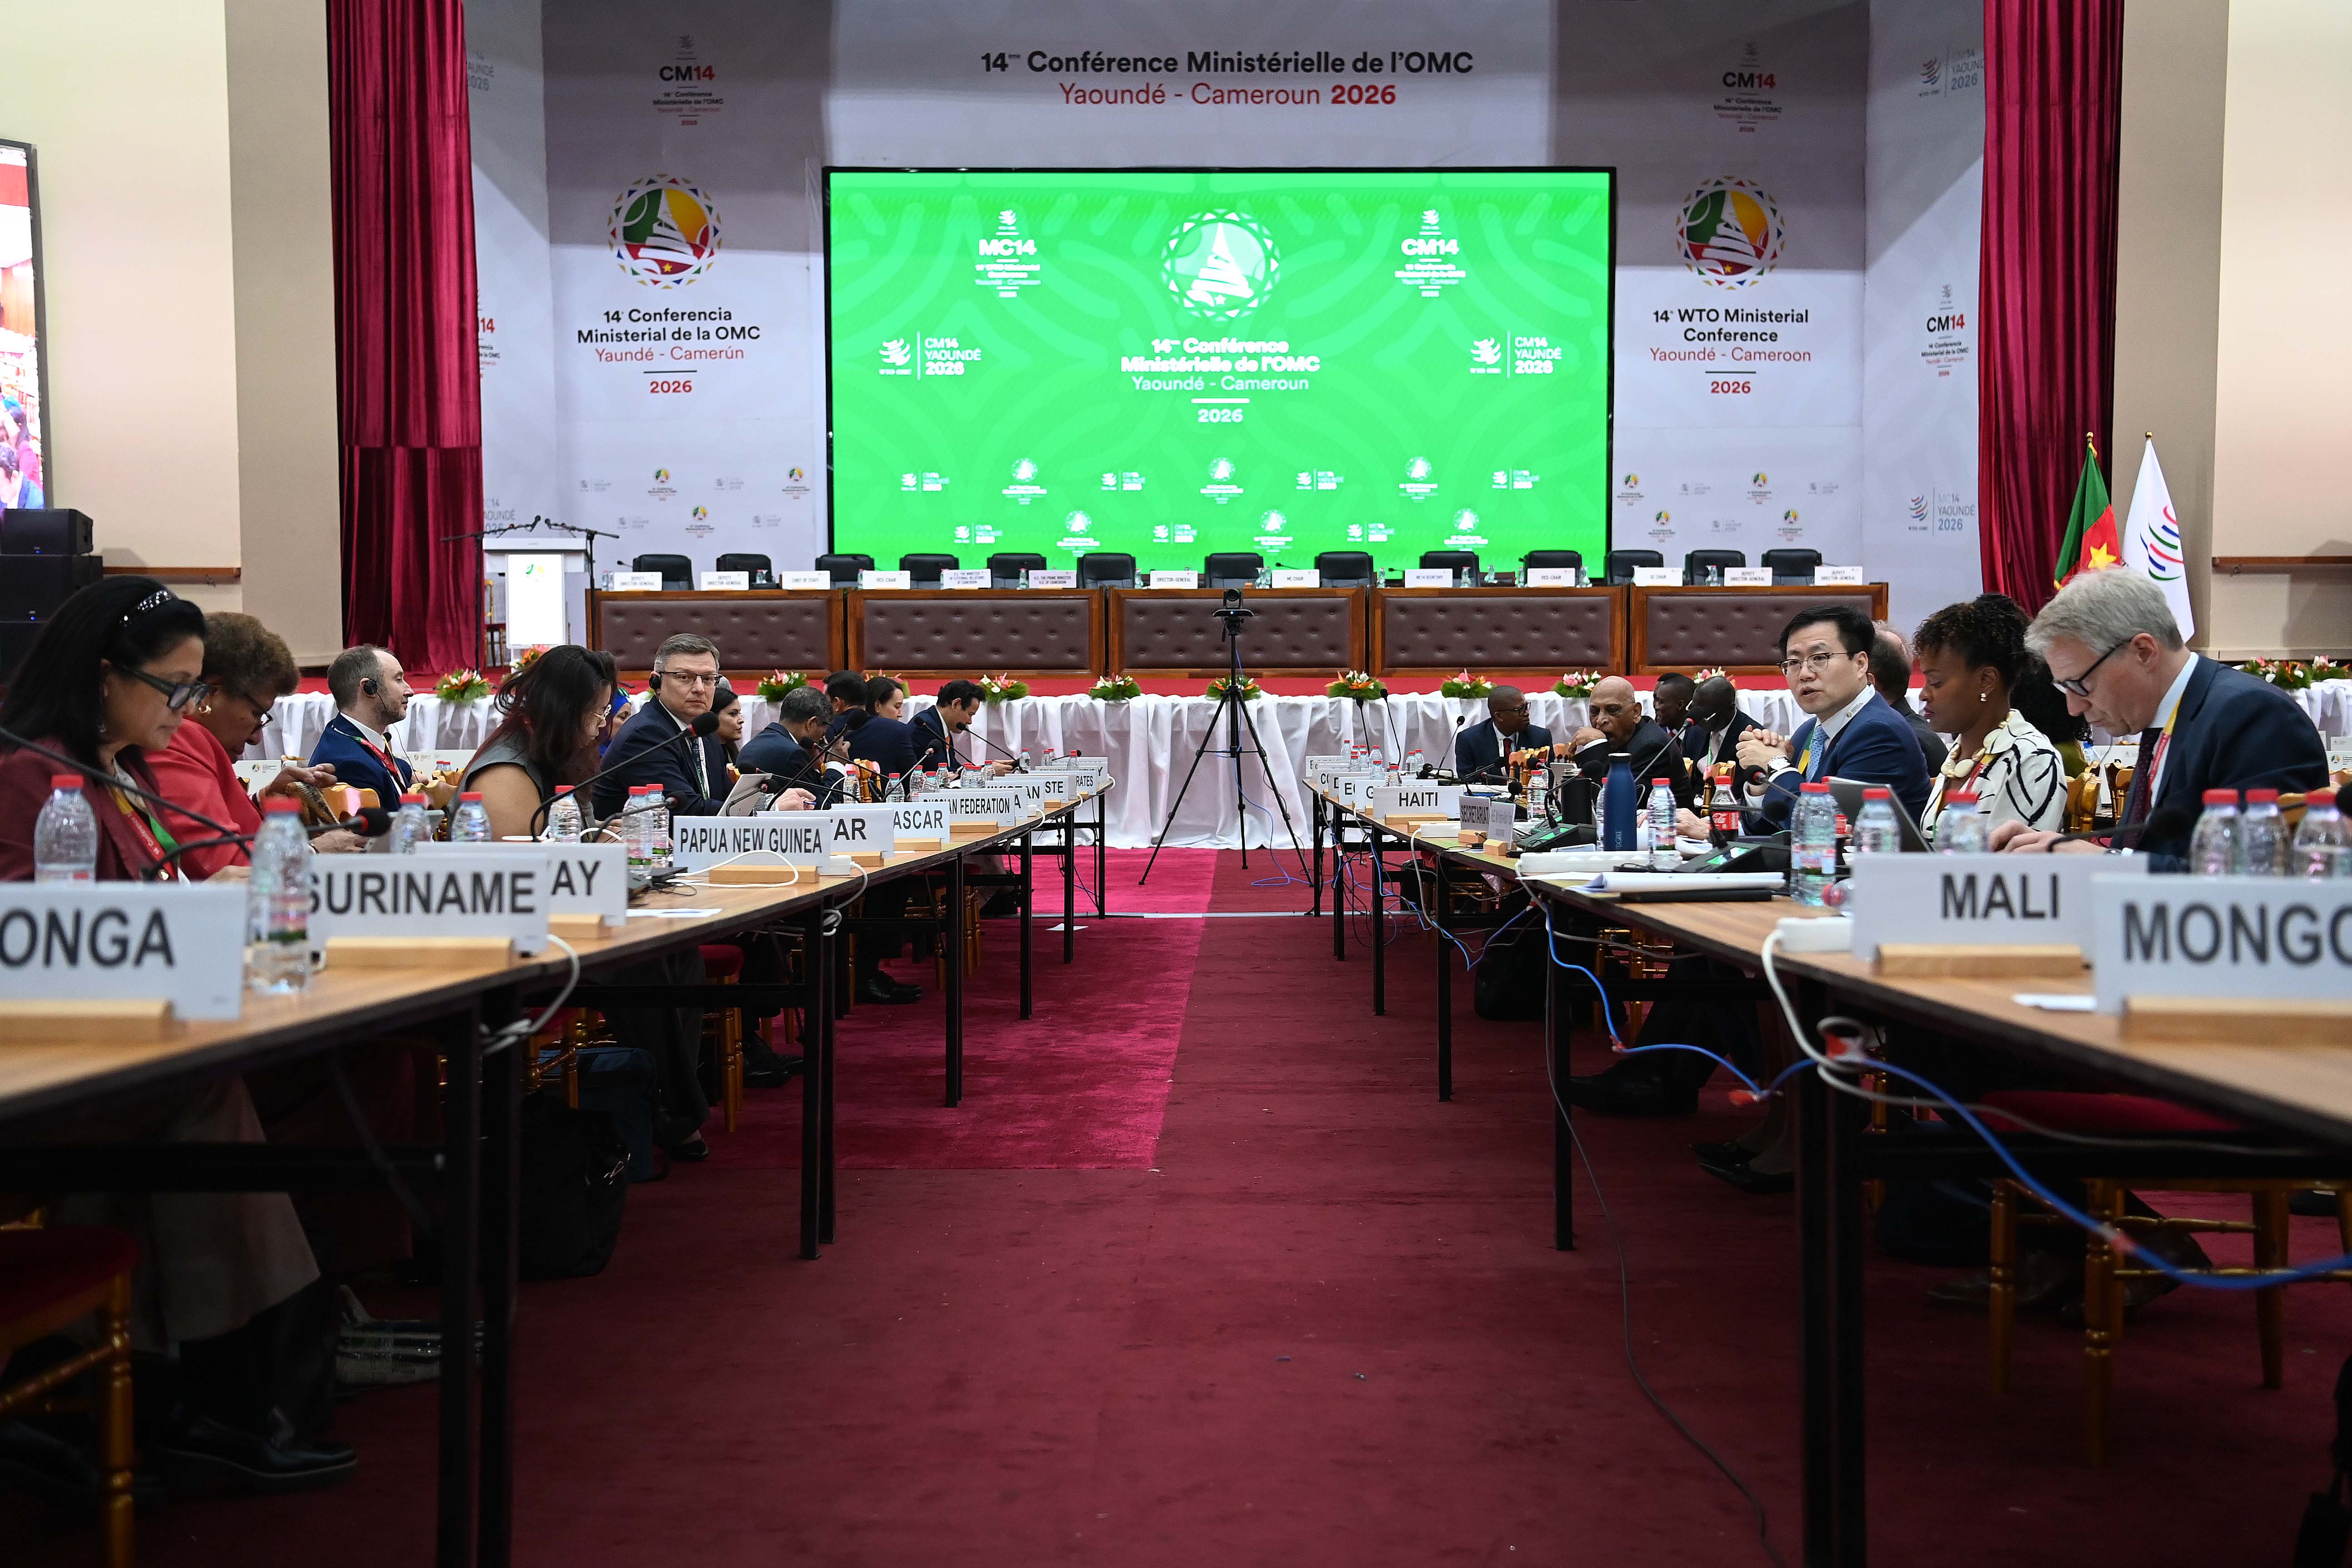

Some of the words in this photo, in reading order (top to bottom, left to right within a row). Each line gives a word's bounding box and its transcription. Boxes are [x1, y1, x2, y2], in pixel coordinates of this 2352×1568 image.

[1028, 50, 1178, 73] Conférence
[1187, 51, 1345, 73] Ministérielle
[1352, 51, 1383, 73] de
[660, 65, 716, 81] CM14
[1722, 71, 1776, 89] CM14
[1059, 82, 1166, 105] Yaoundé
[1191, 83, 1320, 105] Cameroun
[1331, 84, 1396, 105] 2026
[979, 238, 1037, 256] MC14
[1401, 238, 1460, 256] CM14
[628, 307, 732, 323] Conferencia
[1678, 308, 1719, 323] WTO
[1724, 308, 1808, 323] Ministerial
[1927, 313, 1965, 332] CM14
[577, 327, 666, 343] Ministerial
[671, 327, 692, 341] de
[697, 327, 710, 340] la
[715, 326, 761, 340] OMC
[1684, 327, 1778, 342] Conference
[1182, 337, 1290, 354] Conférence
[1514, 346, 1562, 360] YAUNDÉ
[595, 347, 654, 362] Yaundé
[670, 346, 744, 361] Camerún
[924, 348, 982, 361] YAOUNDÉ
[1650, 347, 1715, 362] Yaoundé
[1731, 346, 1811, 362] Cameroon
[925, 361, 965, 375] 2026
[1120, 355, 1232, 372] Ministérielle
[1234, 356, 1259, 372] de
[1514, 360, 1554, 374] 2026
[650, 380, 692, 394] 2026
[1132, 375, 1205, 390] Yaoundé
[1220, 375, 1309, 390] Cameroun
[1710, 381, 1751, 394] 2026
[1197, 409, 1244, 423] 2026
[1938, 518, 1963, 531] 2026
[960, 798, 1010, 814] FEDERATION
[1398, 791, 1438, 807] HAITI
[1461, 804, 1489, 825] SECRETARIAT
[830, 818, 867, 841] AR
[681, 828, 727, 853] PAPUA
[733, 828, 765, 853] NEW
[771, 828, 822, 853] GUINEA
[548, 860, 602, 896] AY
[1940, 872, 2059, 920] MALI
